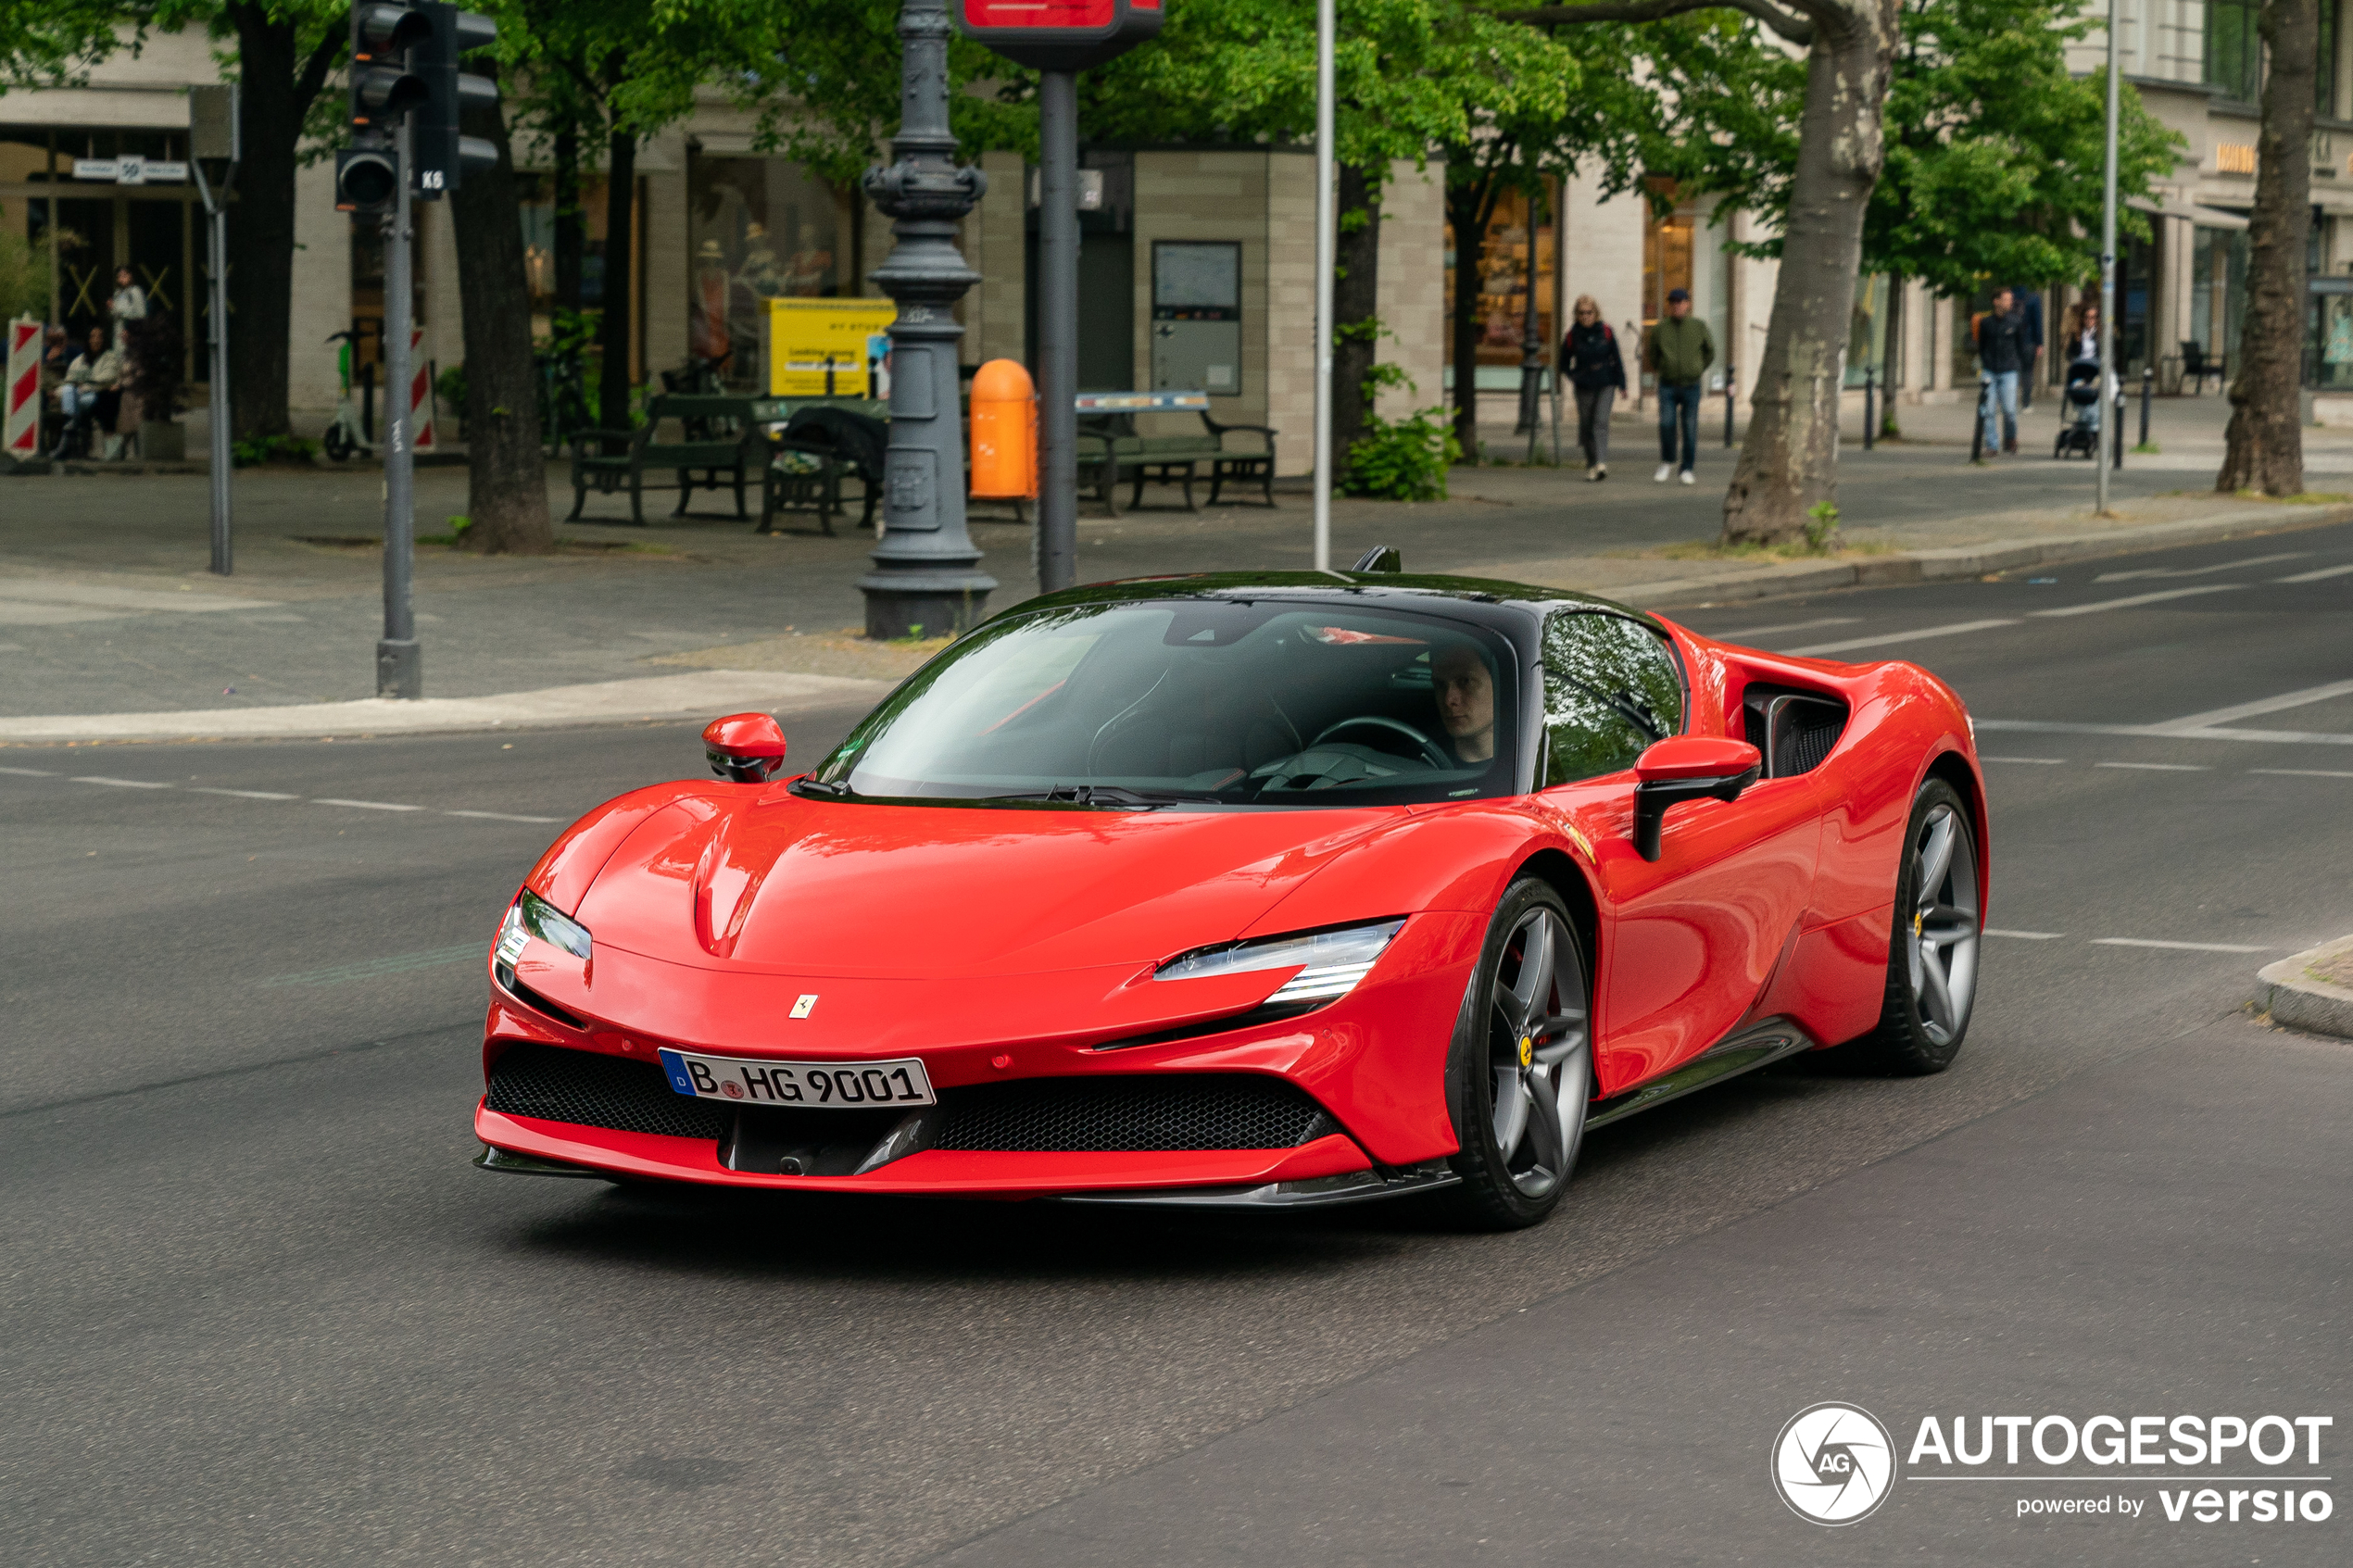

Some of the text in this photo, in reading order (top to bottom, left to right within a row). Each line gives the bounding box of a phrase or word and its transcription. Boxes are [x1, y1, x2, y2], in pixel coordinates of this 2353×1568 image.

[422, 169, 444, 190] K6
[676, 1075, 686, 1087] D
[686, 1060, 924, 1102] B HG 9001
